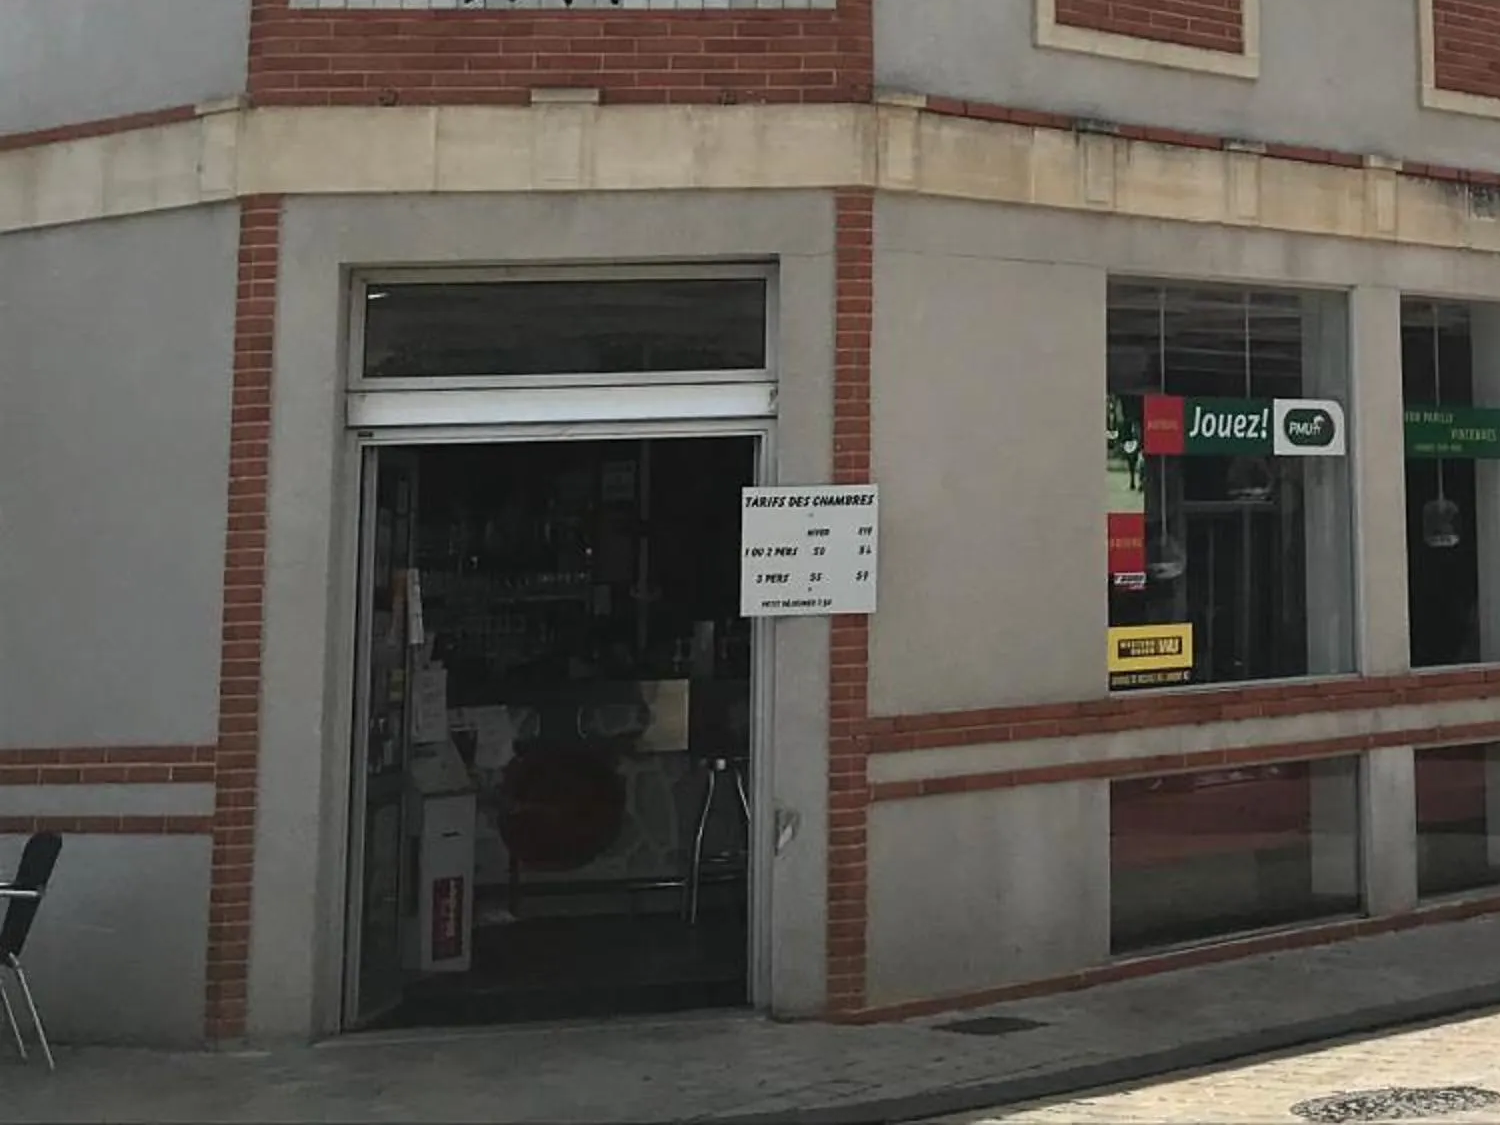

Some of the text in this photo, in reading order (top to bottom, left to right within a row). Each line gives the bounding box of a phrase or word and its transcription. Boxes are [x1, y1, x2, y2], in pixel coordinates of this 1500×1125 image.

[1189, 406, 1269, 439] Jouez!
[1289, 421, 1313, 436] PMU
[745, 494, 875, 507] TARIFS DES CHAMBRES
[765, 573, 790, 583] PERS
